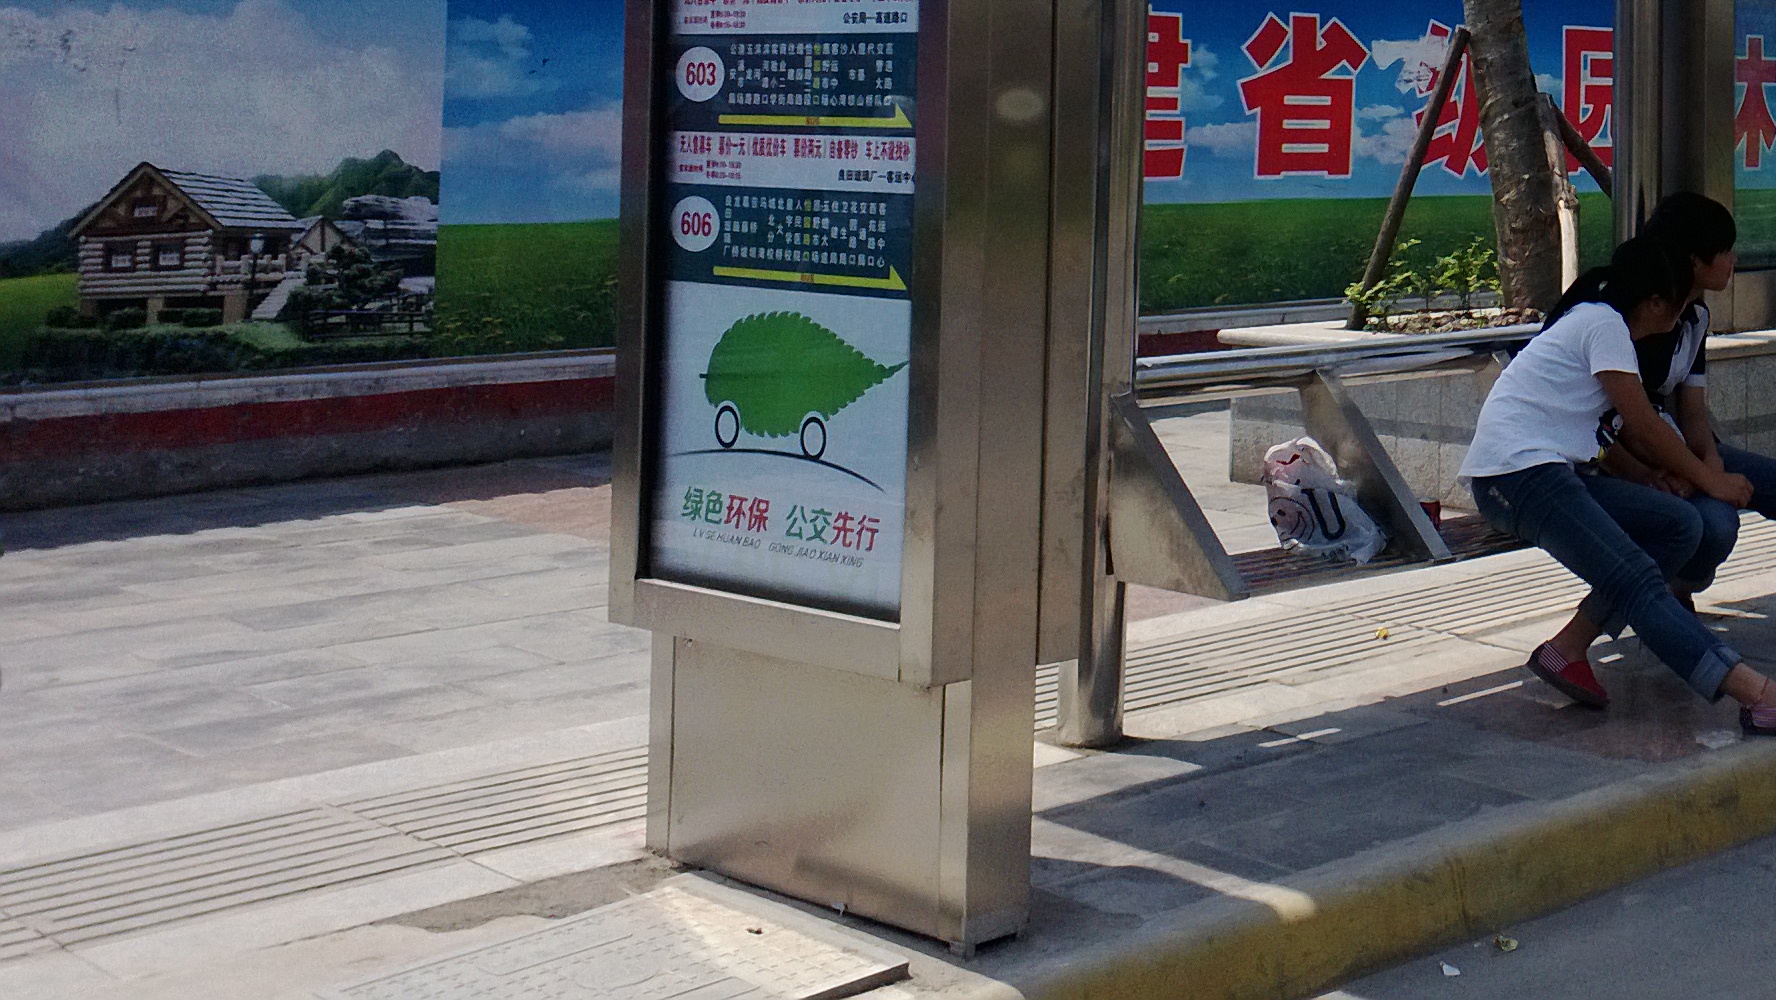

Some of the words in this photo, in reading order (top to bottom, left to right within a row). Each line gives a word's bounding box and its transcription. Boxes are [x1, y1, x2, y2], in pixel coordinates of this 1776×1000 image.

[685, 60, 717, 86] 603
[680, 210, 712, 238] 606
[681, 486, 770, 533] 绿色环保
[785, 504, 881, 552] 公交先行
